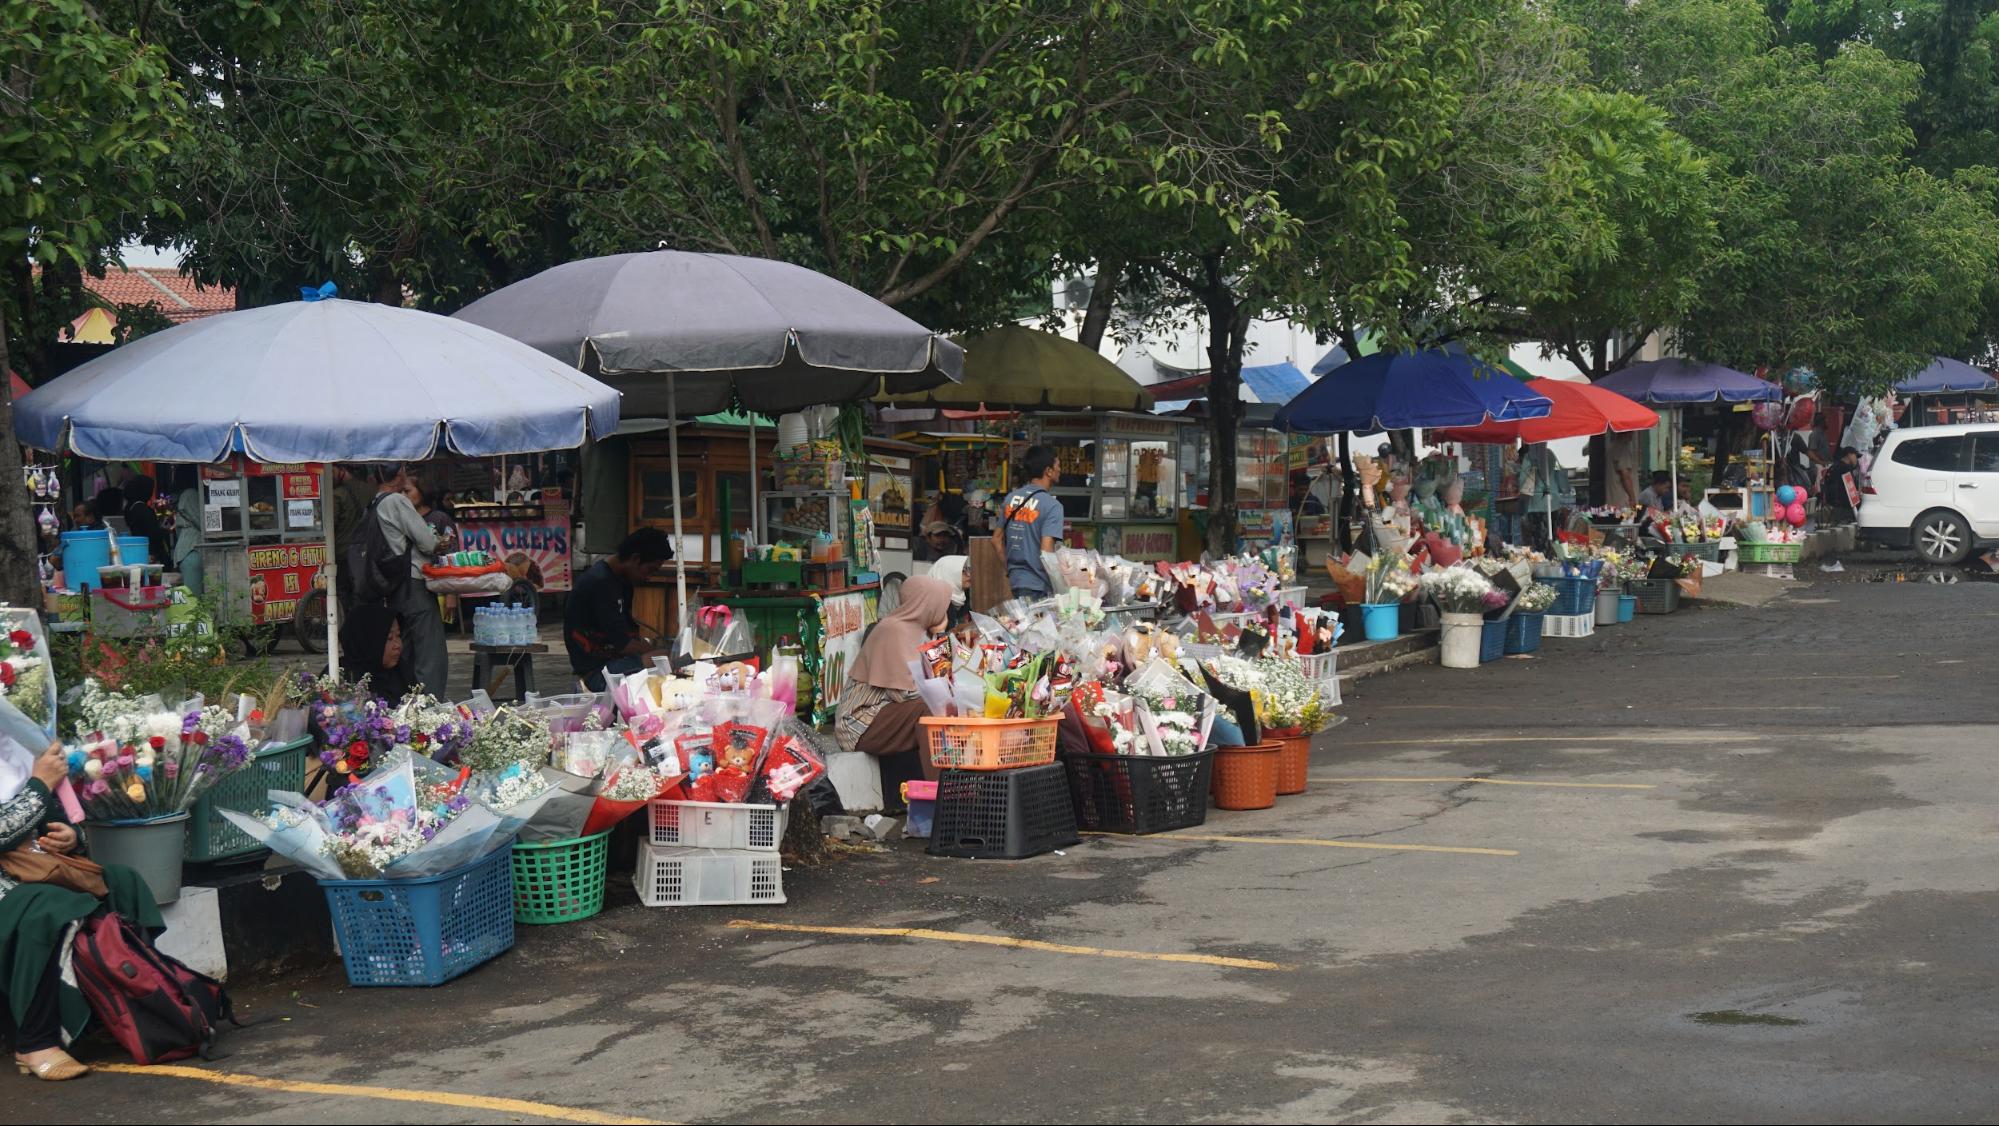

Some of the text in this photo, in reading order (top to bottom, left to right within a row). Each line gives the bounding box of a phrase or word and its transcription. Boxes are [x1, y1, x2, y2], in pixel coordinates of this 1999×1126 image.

[502, 527, 568, 555] CREPS
[249, 549, 288, 569] CIRENG
[289, 547, 299, 567] &
[284, 573, 299, 593] ISI
[264, 600, 296, 620] AYAM
